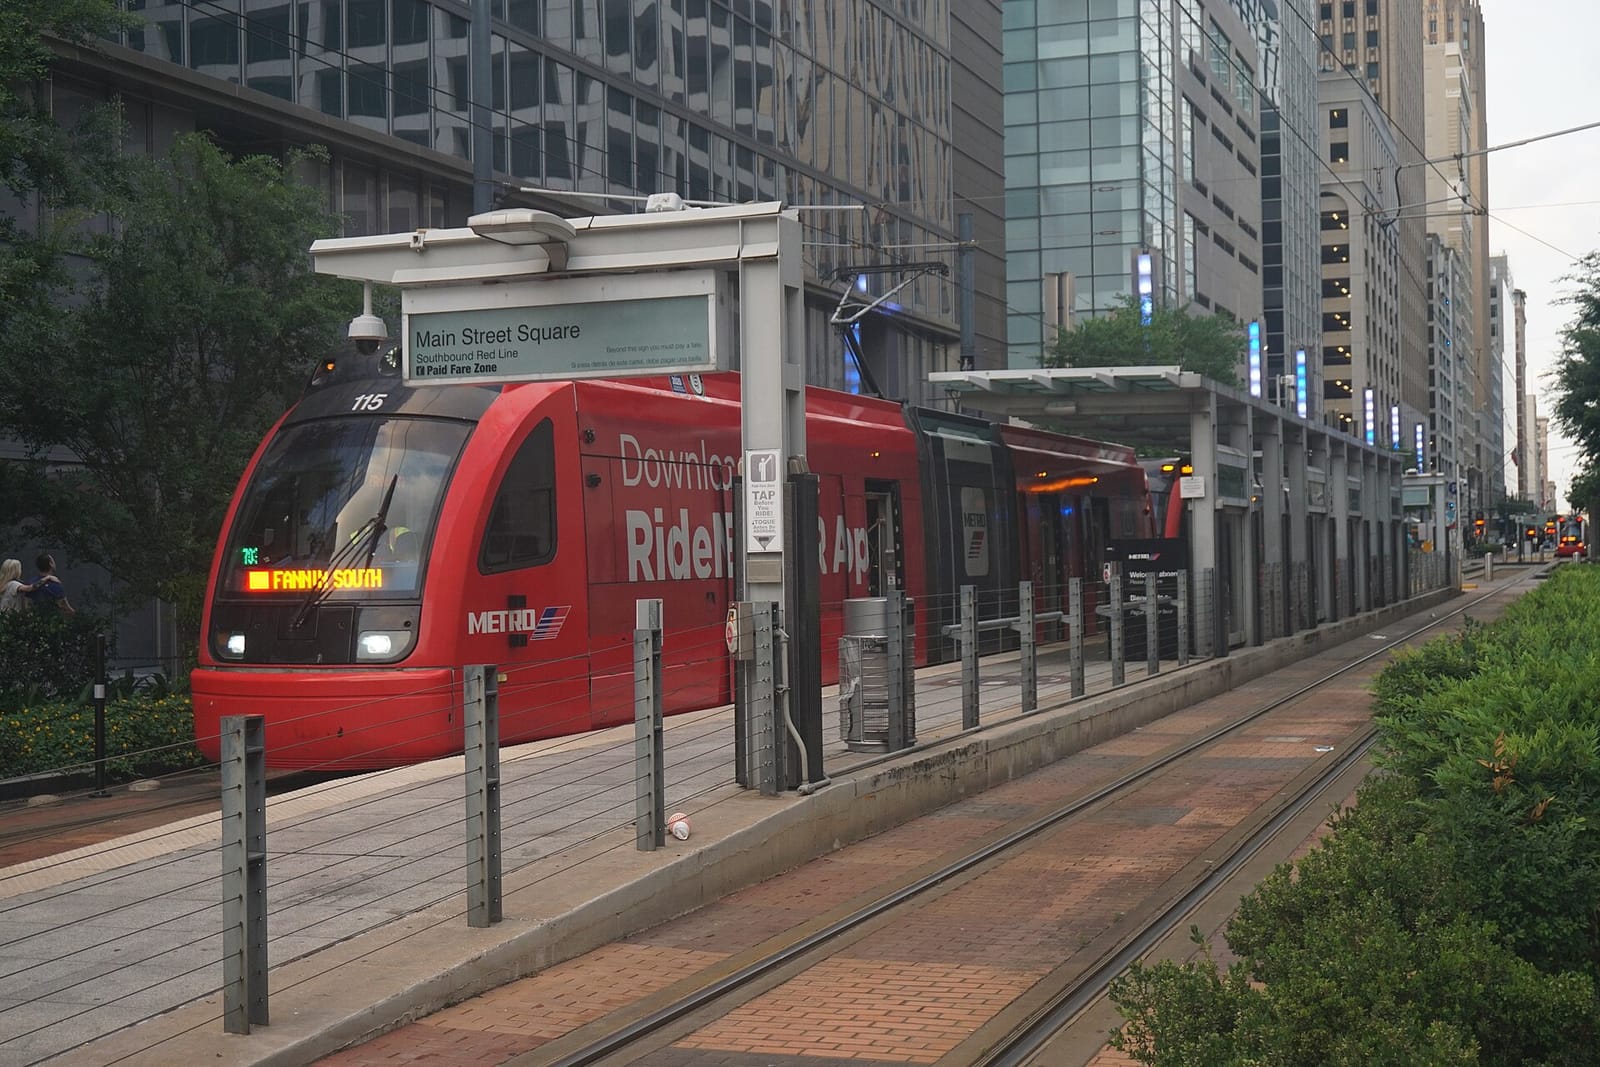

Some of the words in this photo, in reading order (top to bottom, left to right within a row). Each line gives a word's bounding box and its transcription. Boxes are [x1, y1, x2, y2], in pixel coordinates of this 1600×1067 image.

[416, 330, 456, 348] Main
[462, 327, 512, 345] Street
[518, 324, 580, 344] Square
[416, 352, 473, 363] Southbound
[477, 350, 495, 360] Red
[499, 349, 518, 359] Line
[427, 365, 447, 375] Paid
[450, 364, 471, 374] Fare
[474, 363, 497, 373] Zone
[352, 394, 388, 410] 115
[619, 433, 735, 490] Downloa
[752, 491, 775, 500] TAP
[273, 569, 328, 589] FANNIN
[333, 569, 382, 588] SOUTH
[468, 609, 536, 635] METRO
